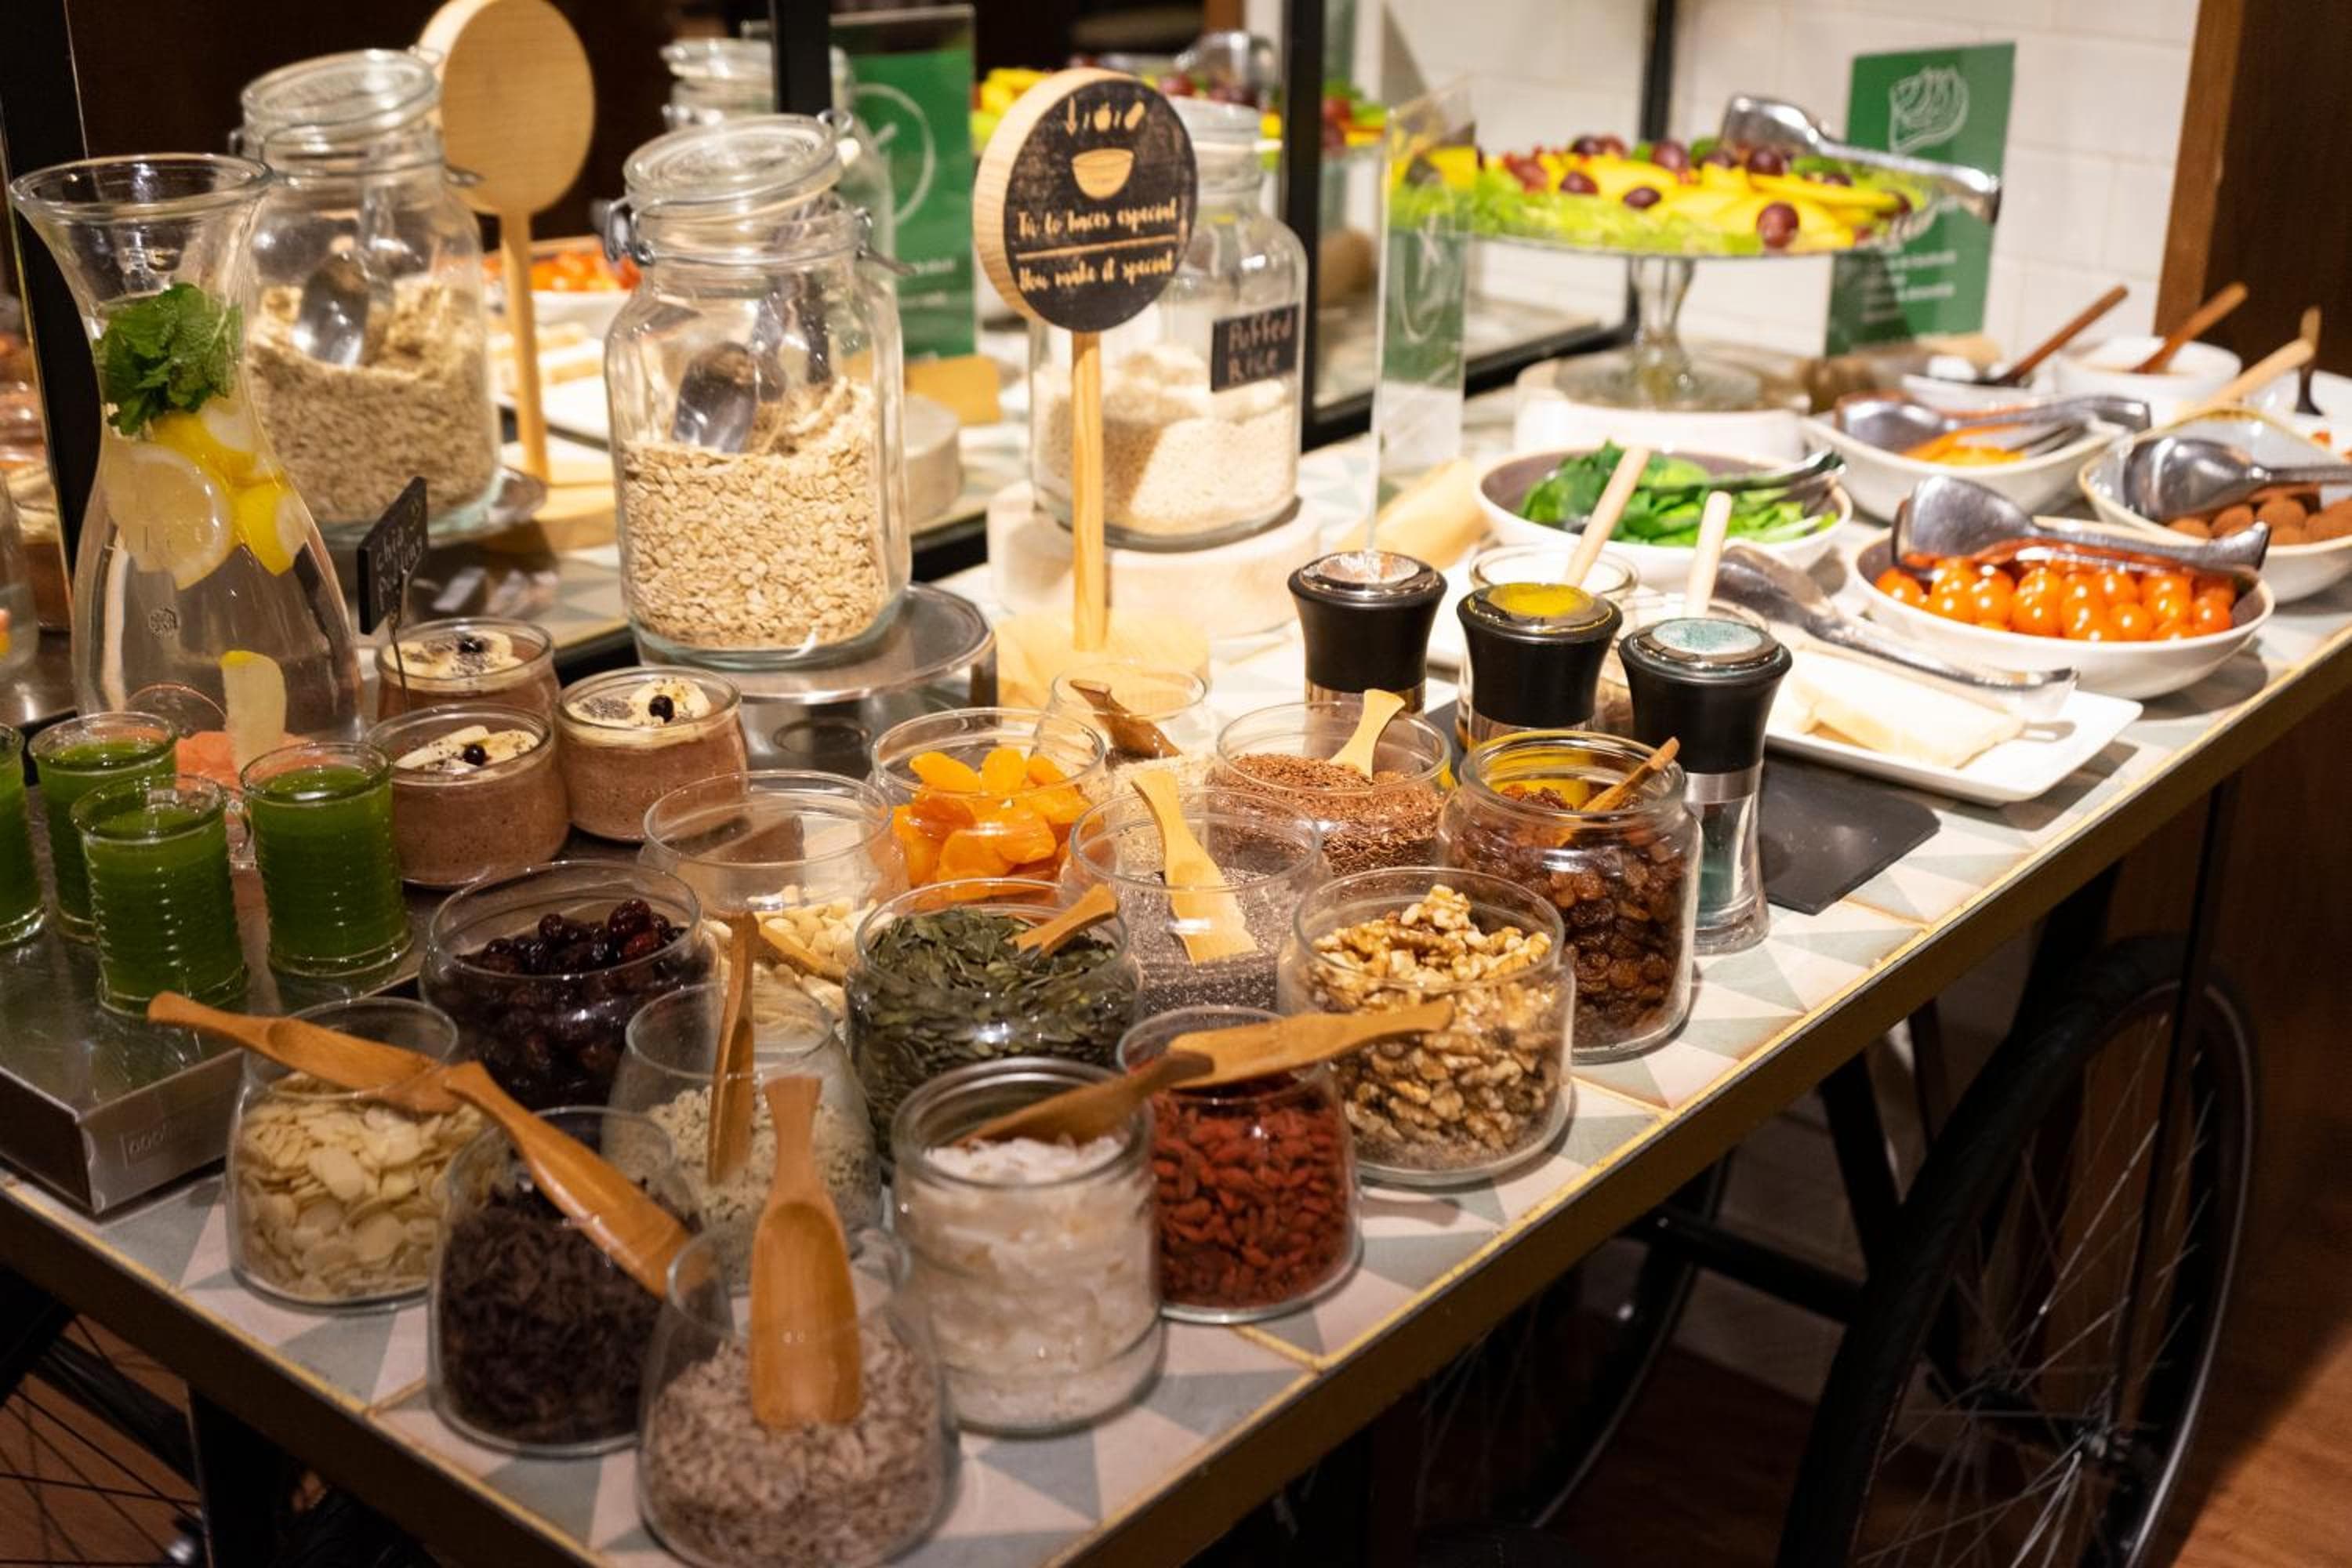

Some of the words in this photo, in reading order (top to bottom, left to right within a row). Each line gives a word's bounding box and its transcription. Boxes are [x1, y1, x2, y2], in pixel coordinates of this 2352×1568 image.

[1044, 211, 1064, 235] lo
[1067, 209, 1111, 233] haces
[1116, 197, 1177, 233] especial
[1054, 260, 1096, 287] make
[1102, 256, 1115, 282] it
[1121, 249, 1173, 286] special
